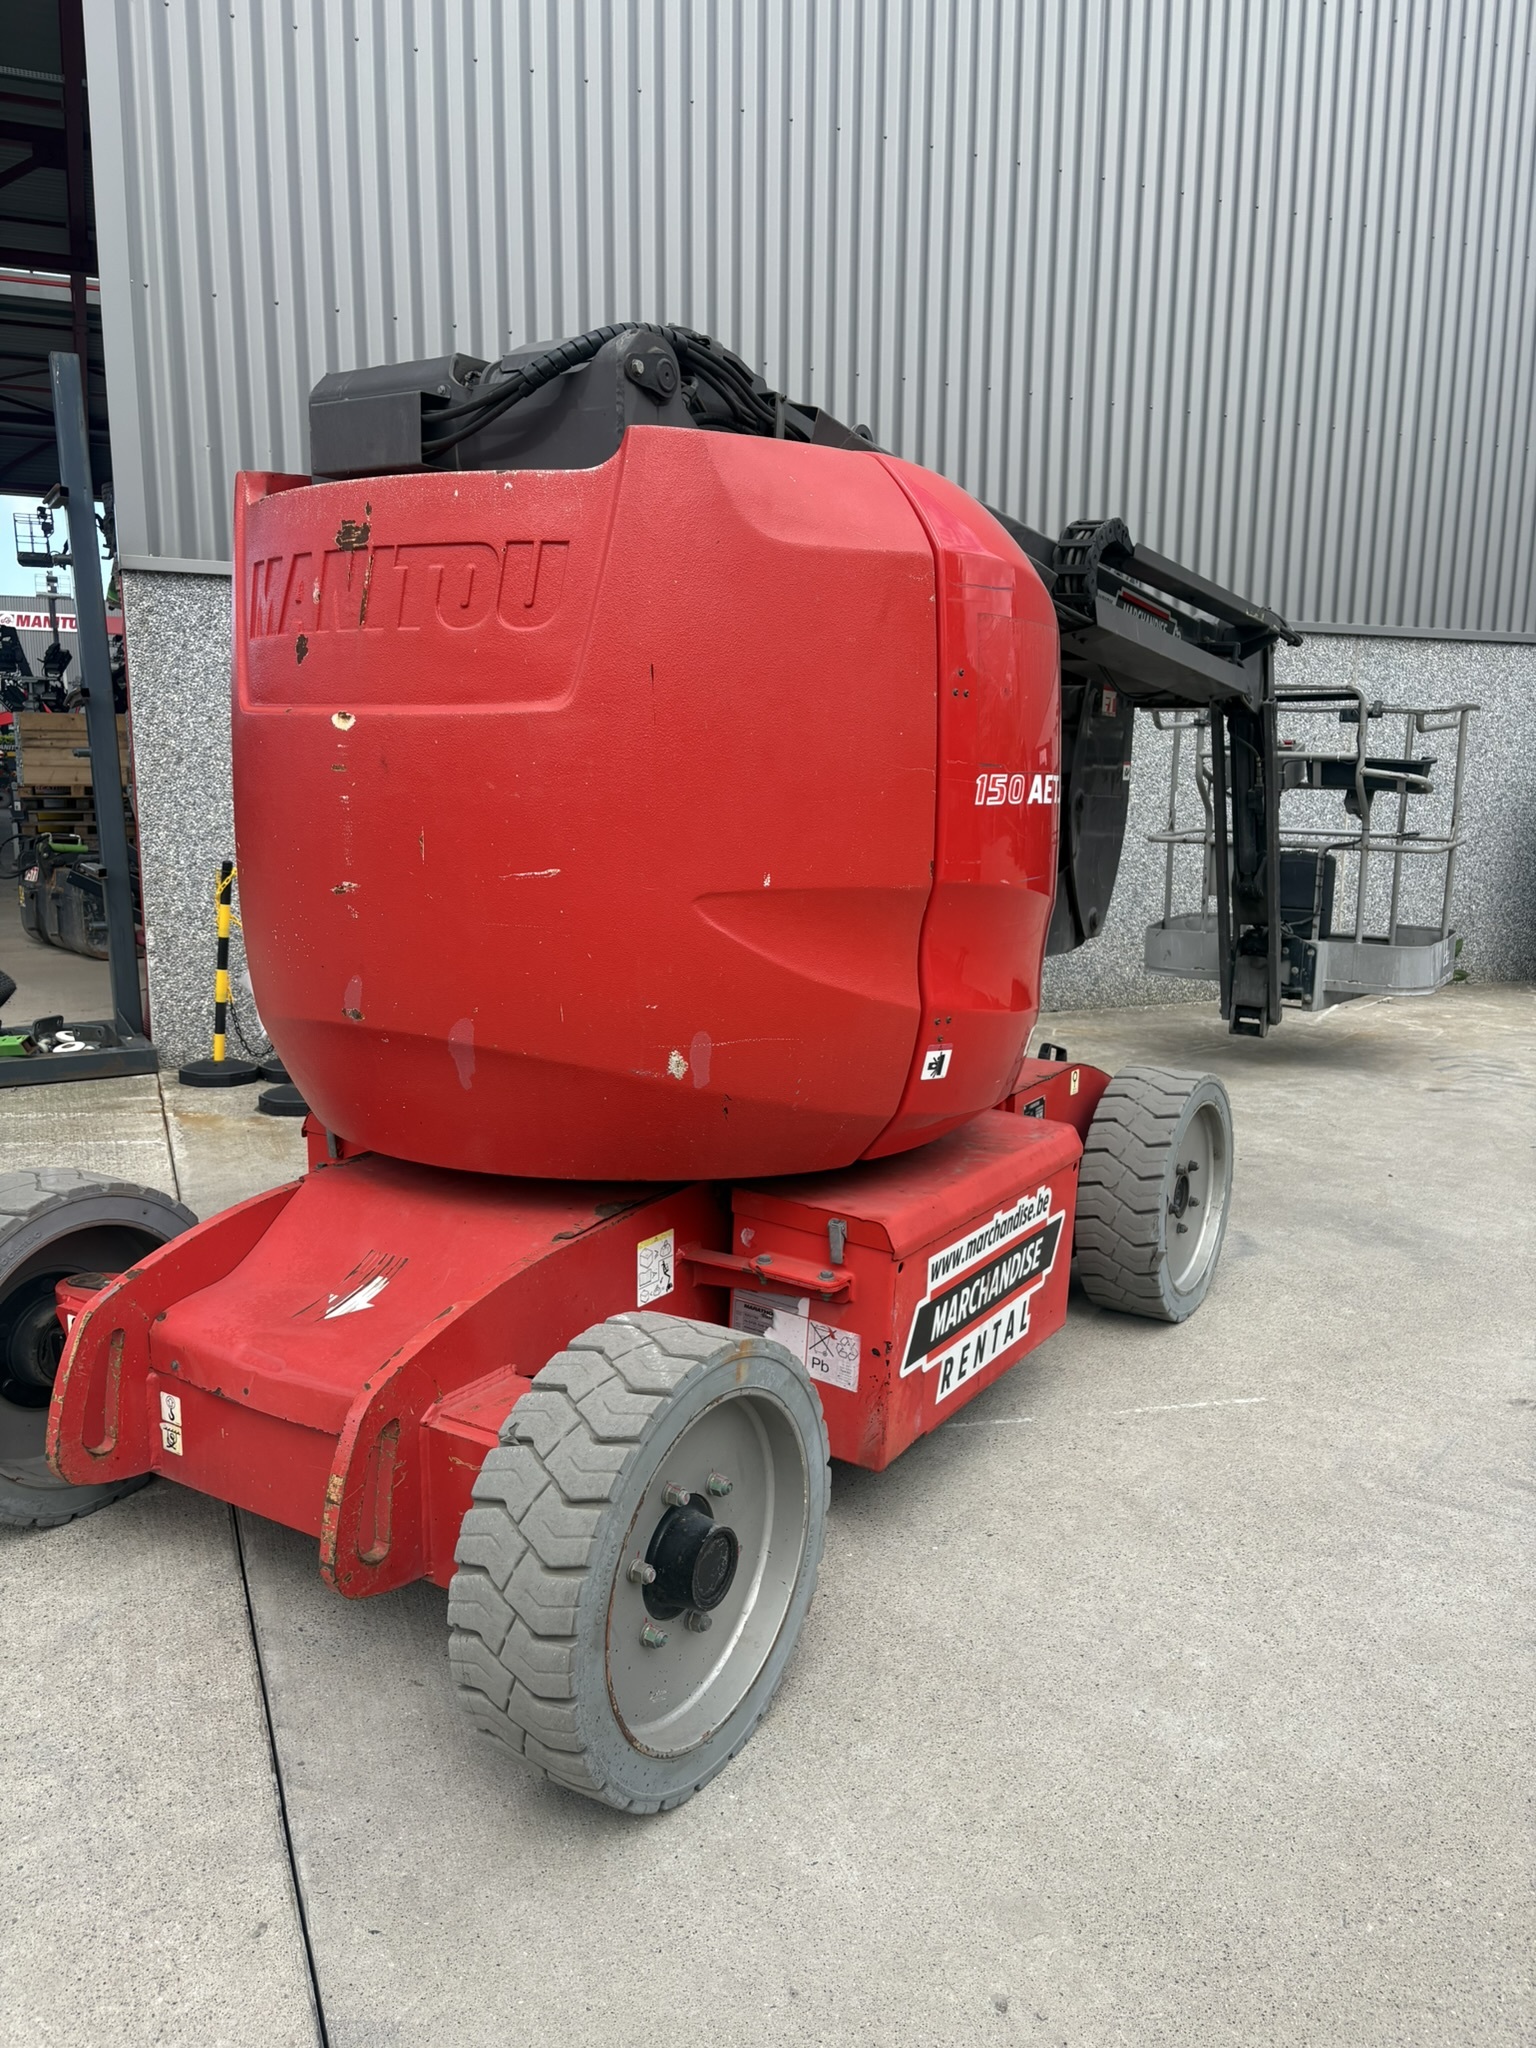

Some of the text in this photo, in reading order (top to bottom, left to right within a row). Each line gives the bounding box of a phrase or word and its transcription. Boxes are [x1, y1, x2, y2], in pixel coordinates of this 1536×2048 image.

[251, 541, 570, 639] MANITOU
[975, 774, 1025, 805] 150
[931, 1193, 1049, 1282] www.marchandise.be
[930, 1237, 1044, 1342] MARCHANDISE
[811, 1356, 830, 1373] Pb
[940, 1301, 1028, 1394] RENTAL
